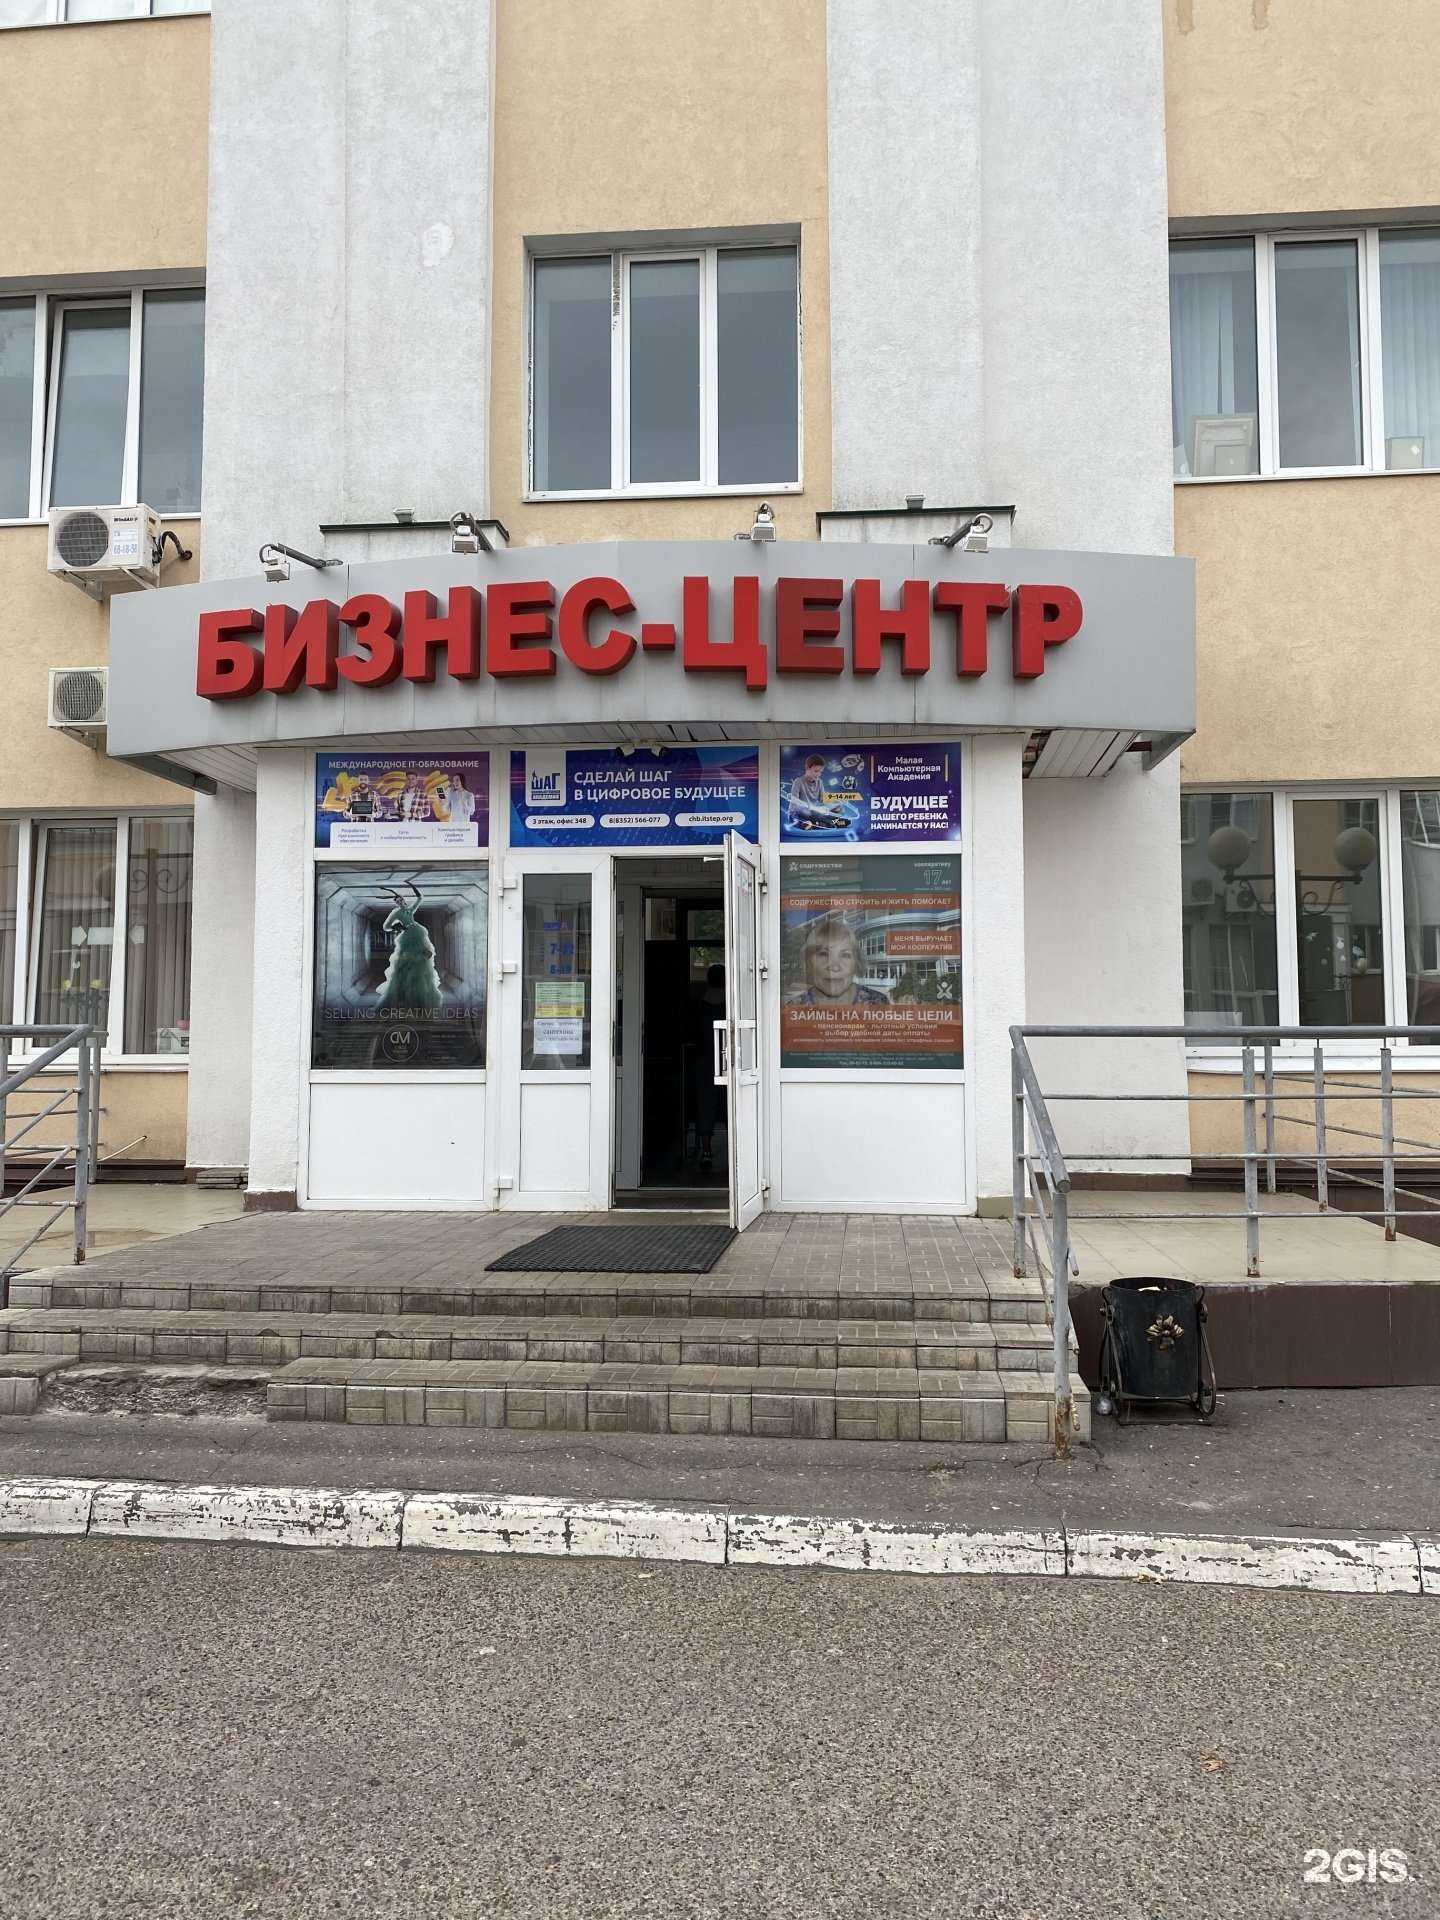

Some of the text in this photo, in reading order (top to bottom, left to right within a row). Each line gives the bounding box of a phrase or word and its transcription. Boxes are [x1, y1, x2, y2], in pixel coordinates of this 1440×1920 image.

[197, 576, 1083, 702] БИЗНЕС-ЦЕНТР
[328, 760, 480, 770] МЕЖДУНАРОДНОЕ IT-ОБРАЗОВАНИЕ
[895, 756, 923, 764] Малая
[877, 764, 941, 774] Компьютерная
[531, 770, 561, 790] ШАГ
[574, 769, 673, 785] СДЕЛАЙ ШАГ
[887, 773, 931, 782] Академия
[574, 786, 746, 802] В ЦИФРОВОЕ БУДУЩЕЕ
[870, 796, 949, 811] БУДУЩЕЕ
[608, 816, 661, 825] 8(8352) 566-077
[688, 815, 734, 825] chb.itstep.org
[870, 812, 949, 821] ВАШЕГО РЕБЕНКА
[871, 822, 922, 830] НАЧИНАЕТСЯ
[930, 821, 949, 829] НАС!
[923, 870, 943, 885] 17
[790, 898, 844, 906] СОДРУЖЕСТВО
[911, 897, 952, 905] ПОМОГАЕТ
[325, 1007, 479, 1019] SELLING CREATIVE IDEAS
[791, 1008, 953, 1022] ЗАЙМЫ НА ЛЮБЫЕ ЦЕЛИ
